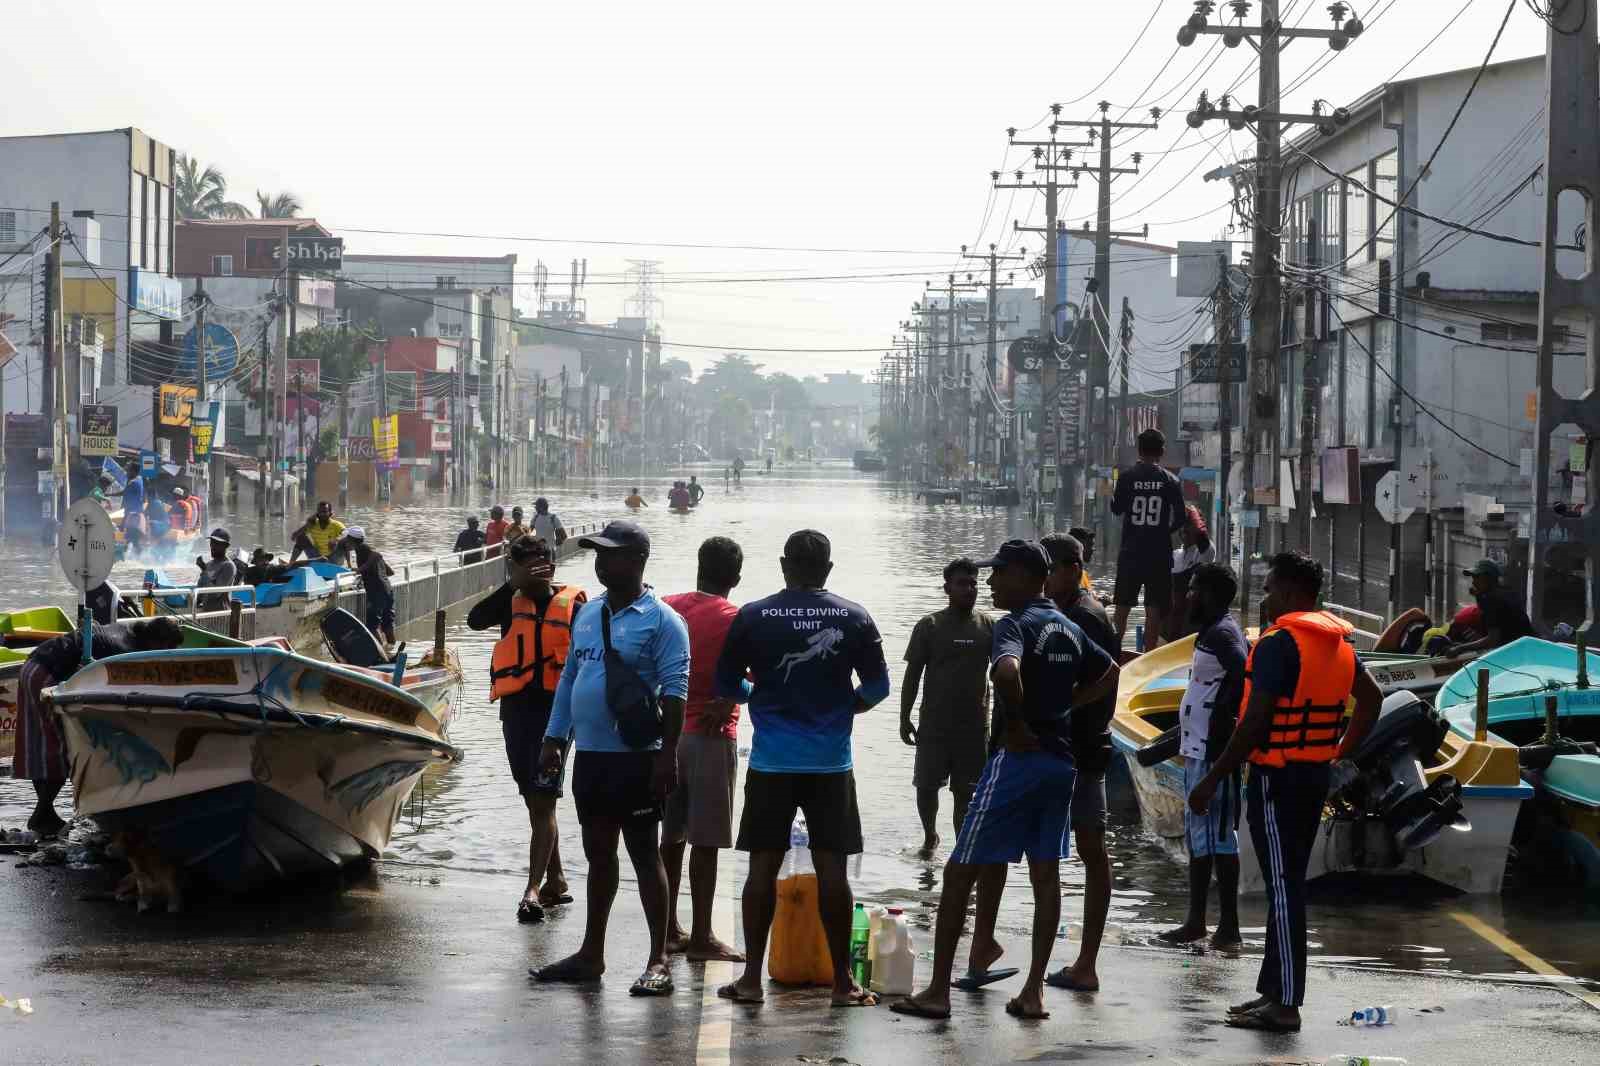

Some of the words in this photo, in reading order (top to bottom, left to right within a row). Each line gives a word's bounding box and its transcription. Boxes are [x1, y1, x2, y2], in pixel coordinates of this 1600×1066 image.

[83, 438, 116, 448] HOUSE
[1131, 495, 1162, 526] 99
[761, 608, 804, 617] POLICE
[807, 608, 849, 617] DIVING
[793, 620, 822, 630] UNIT
